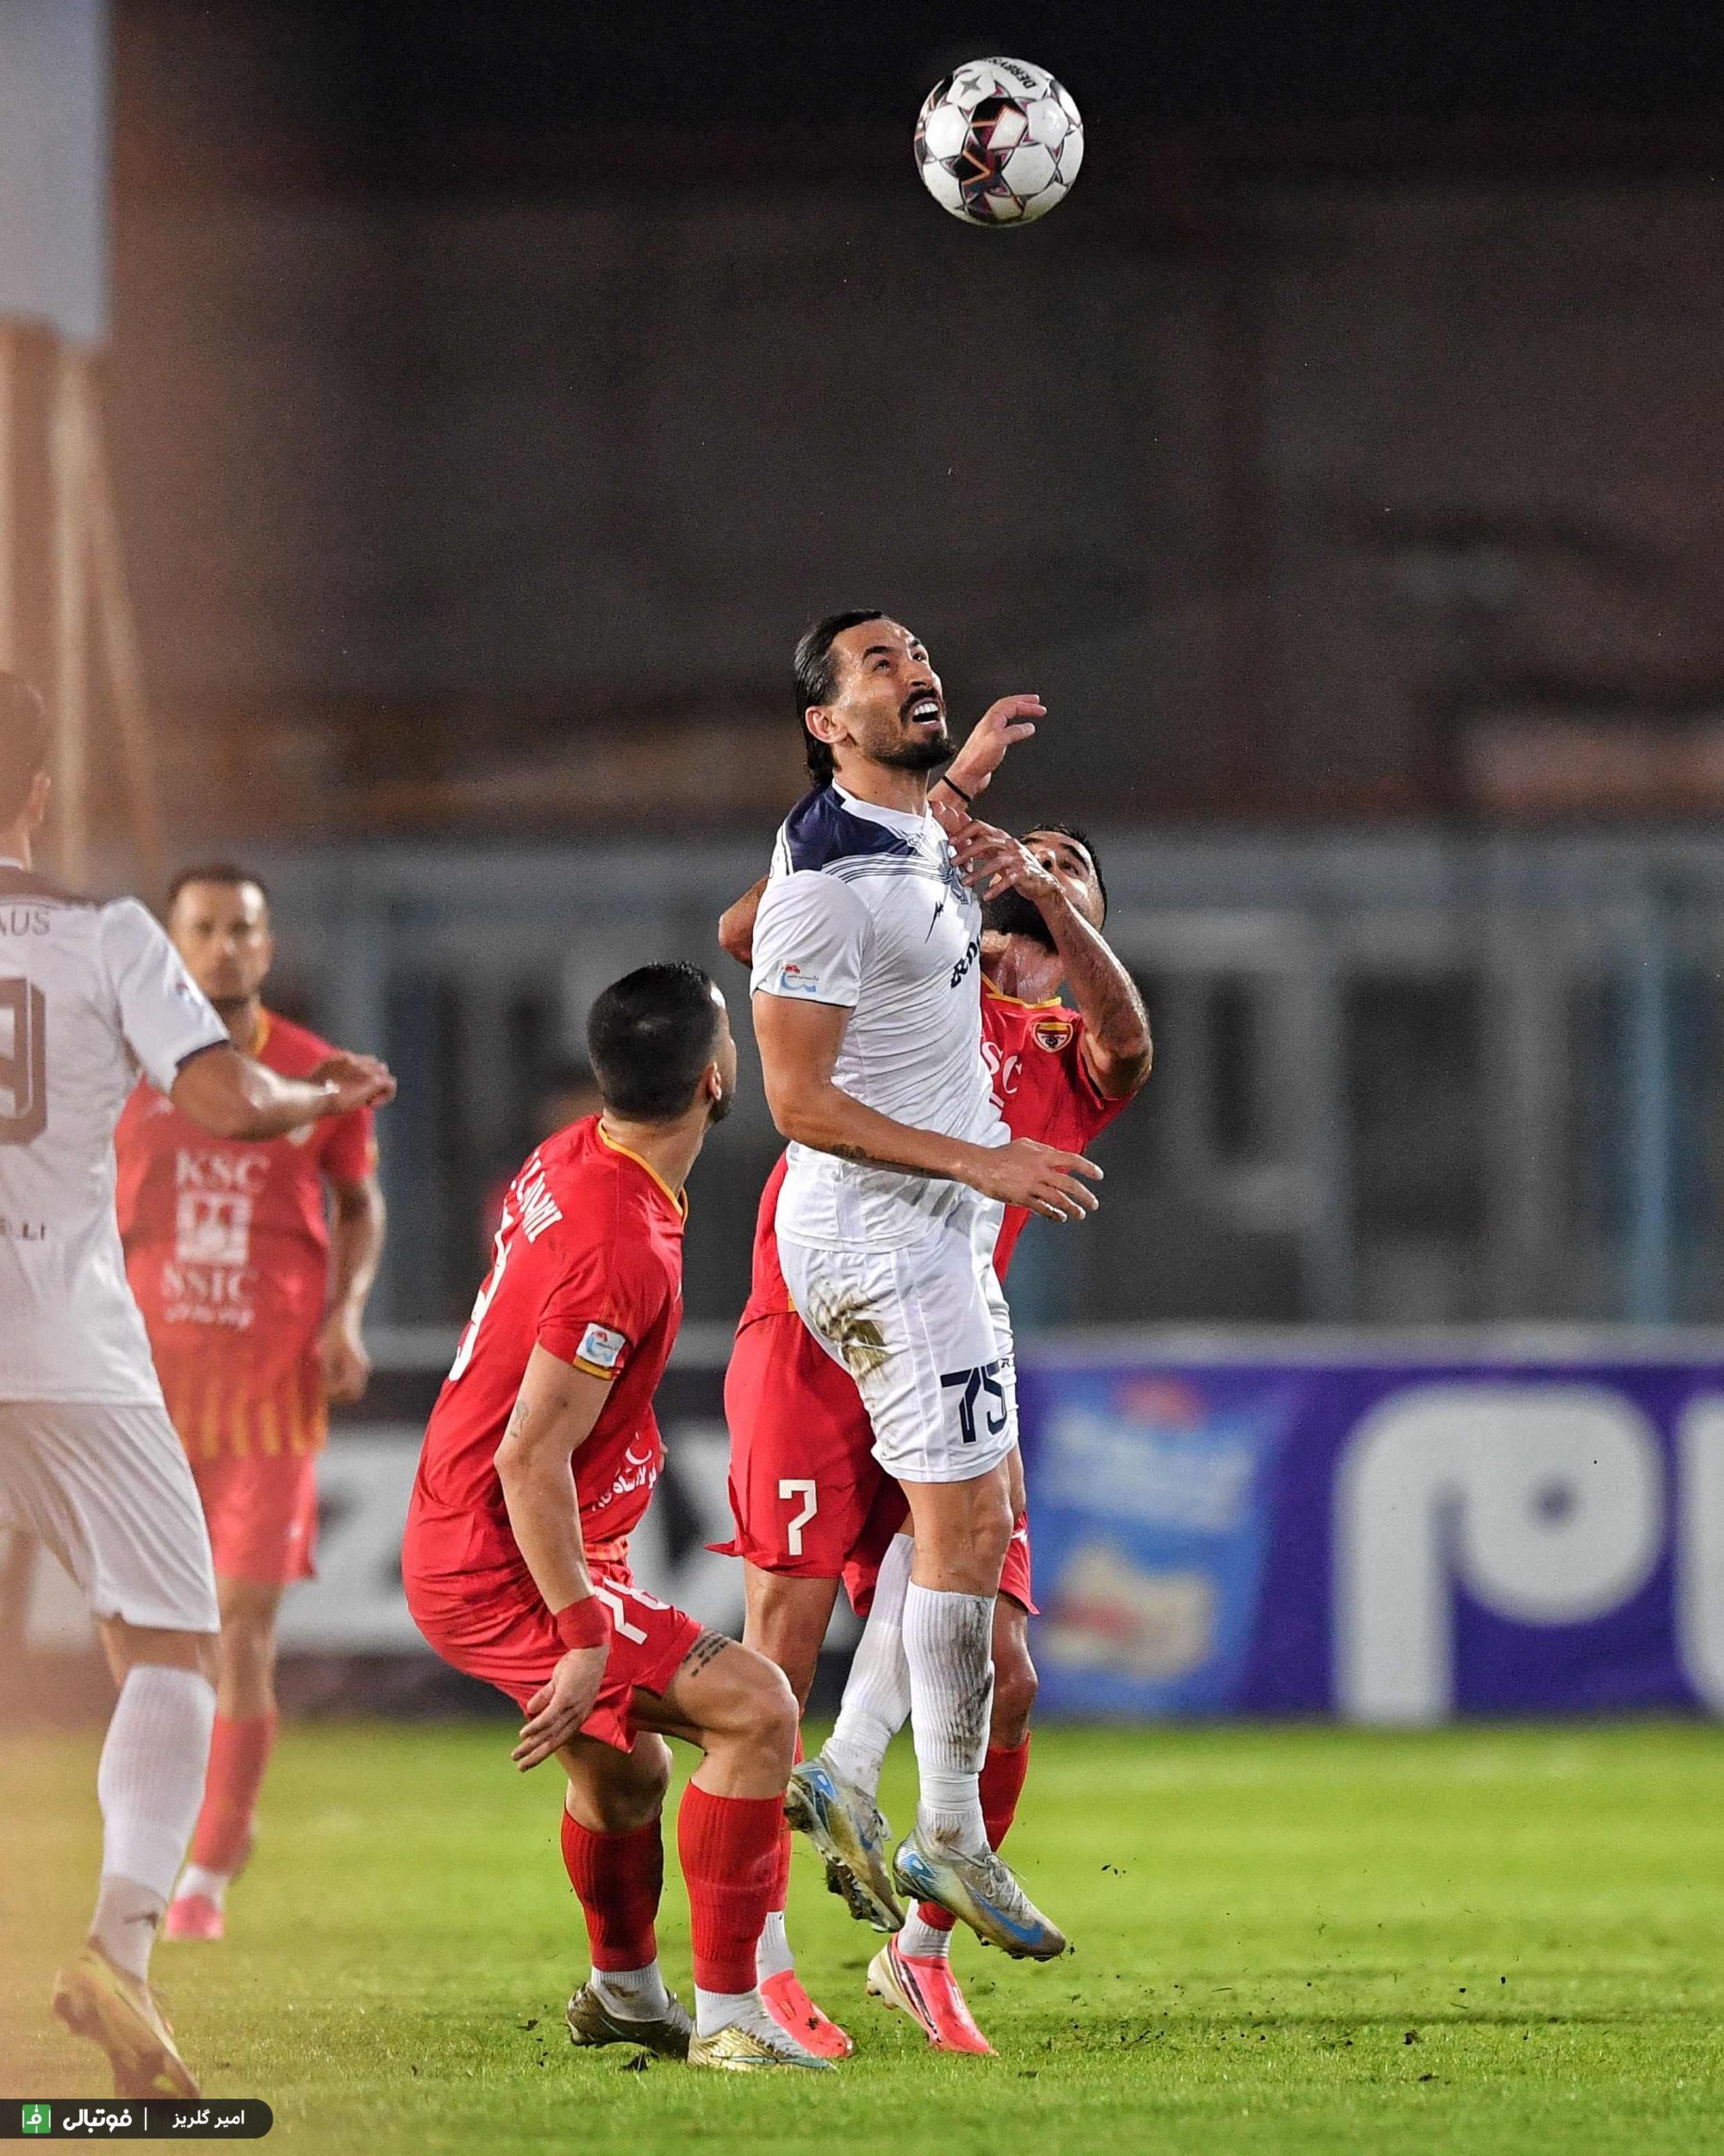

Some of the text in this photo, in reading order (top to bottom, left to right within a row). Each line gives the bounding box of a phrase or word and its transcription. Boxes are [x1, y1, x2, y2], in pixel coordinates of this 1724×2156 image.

[980, 1040, 1023, 1095] SC
[940, 1359, 1008, 1444] 75
[779, 1479, 817, 1556] 7
